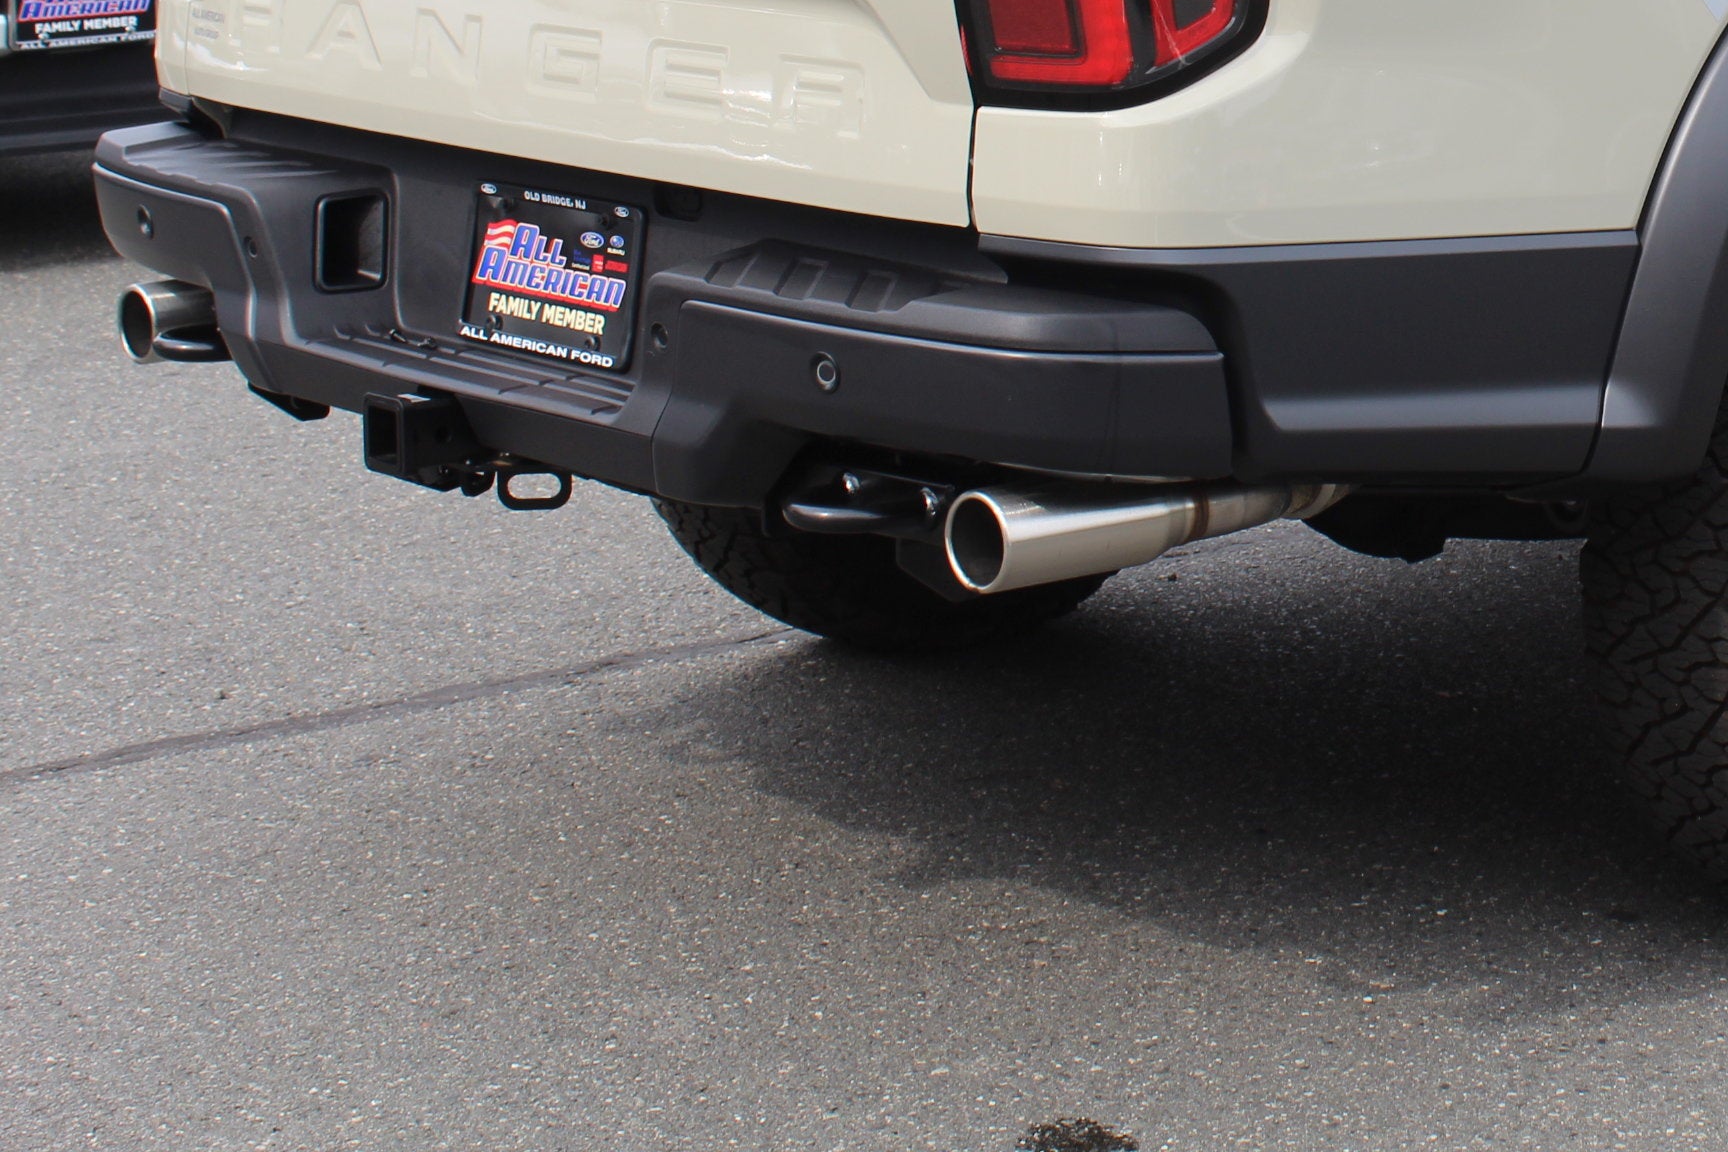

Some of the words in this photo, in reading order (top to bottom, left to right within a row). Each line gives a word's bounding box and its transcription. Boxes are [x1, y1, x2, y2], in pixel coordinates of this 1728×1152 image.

[19, 41, 49, 49] ALL
[48, 36, 119, 48] AMERICAN
[35, 18, 81, 34] FAMILY
[83, 16, 138, 31] MEMBER
[524, 191, 540, 201] OLD
[541, 193, 574, 208] BRIDGE,
[575, 199, 587, 209] NJ
[509, 223, 567, 267] ALL
[476, 246, 627, 309] AMERICAN
[488, 292, 542, 322] FAMILY
[541, 304, 606, 335] MEMBER
[460, 326, 489, 341] ALL
[490, 333, 573, 358] AMERICAN
[571, 351, 614, 368] FORD
